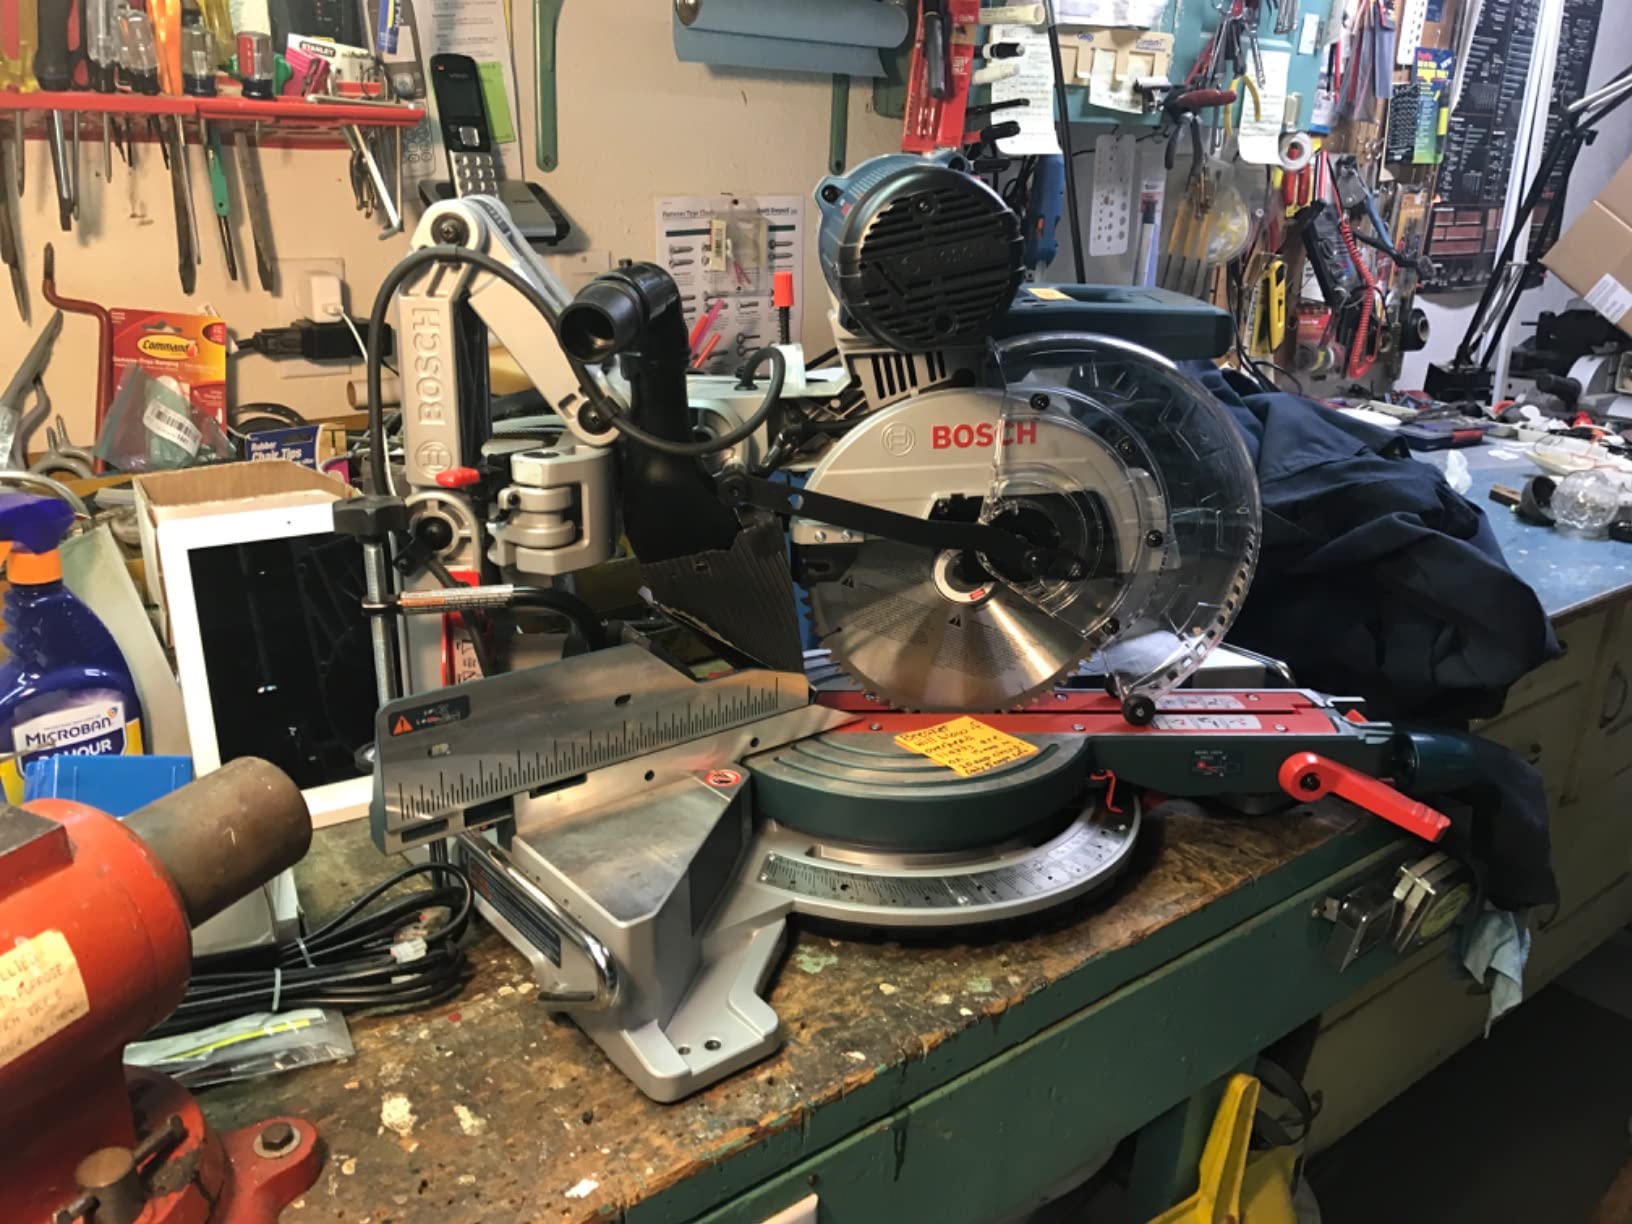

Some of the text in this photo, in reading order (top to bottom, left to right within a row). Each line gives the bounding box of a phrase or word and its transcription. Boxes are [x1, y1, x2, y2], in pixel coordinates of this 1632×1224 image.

[300, 40, 336, 57] STANLEY
[142, 339, 190, 353] Command
[411, 307, 446, 425] BOSCH
[931, 421, 1037, 449] BOSCH
[25, 717, 112, 747] MICROBAN
